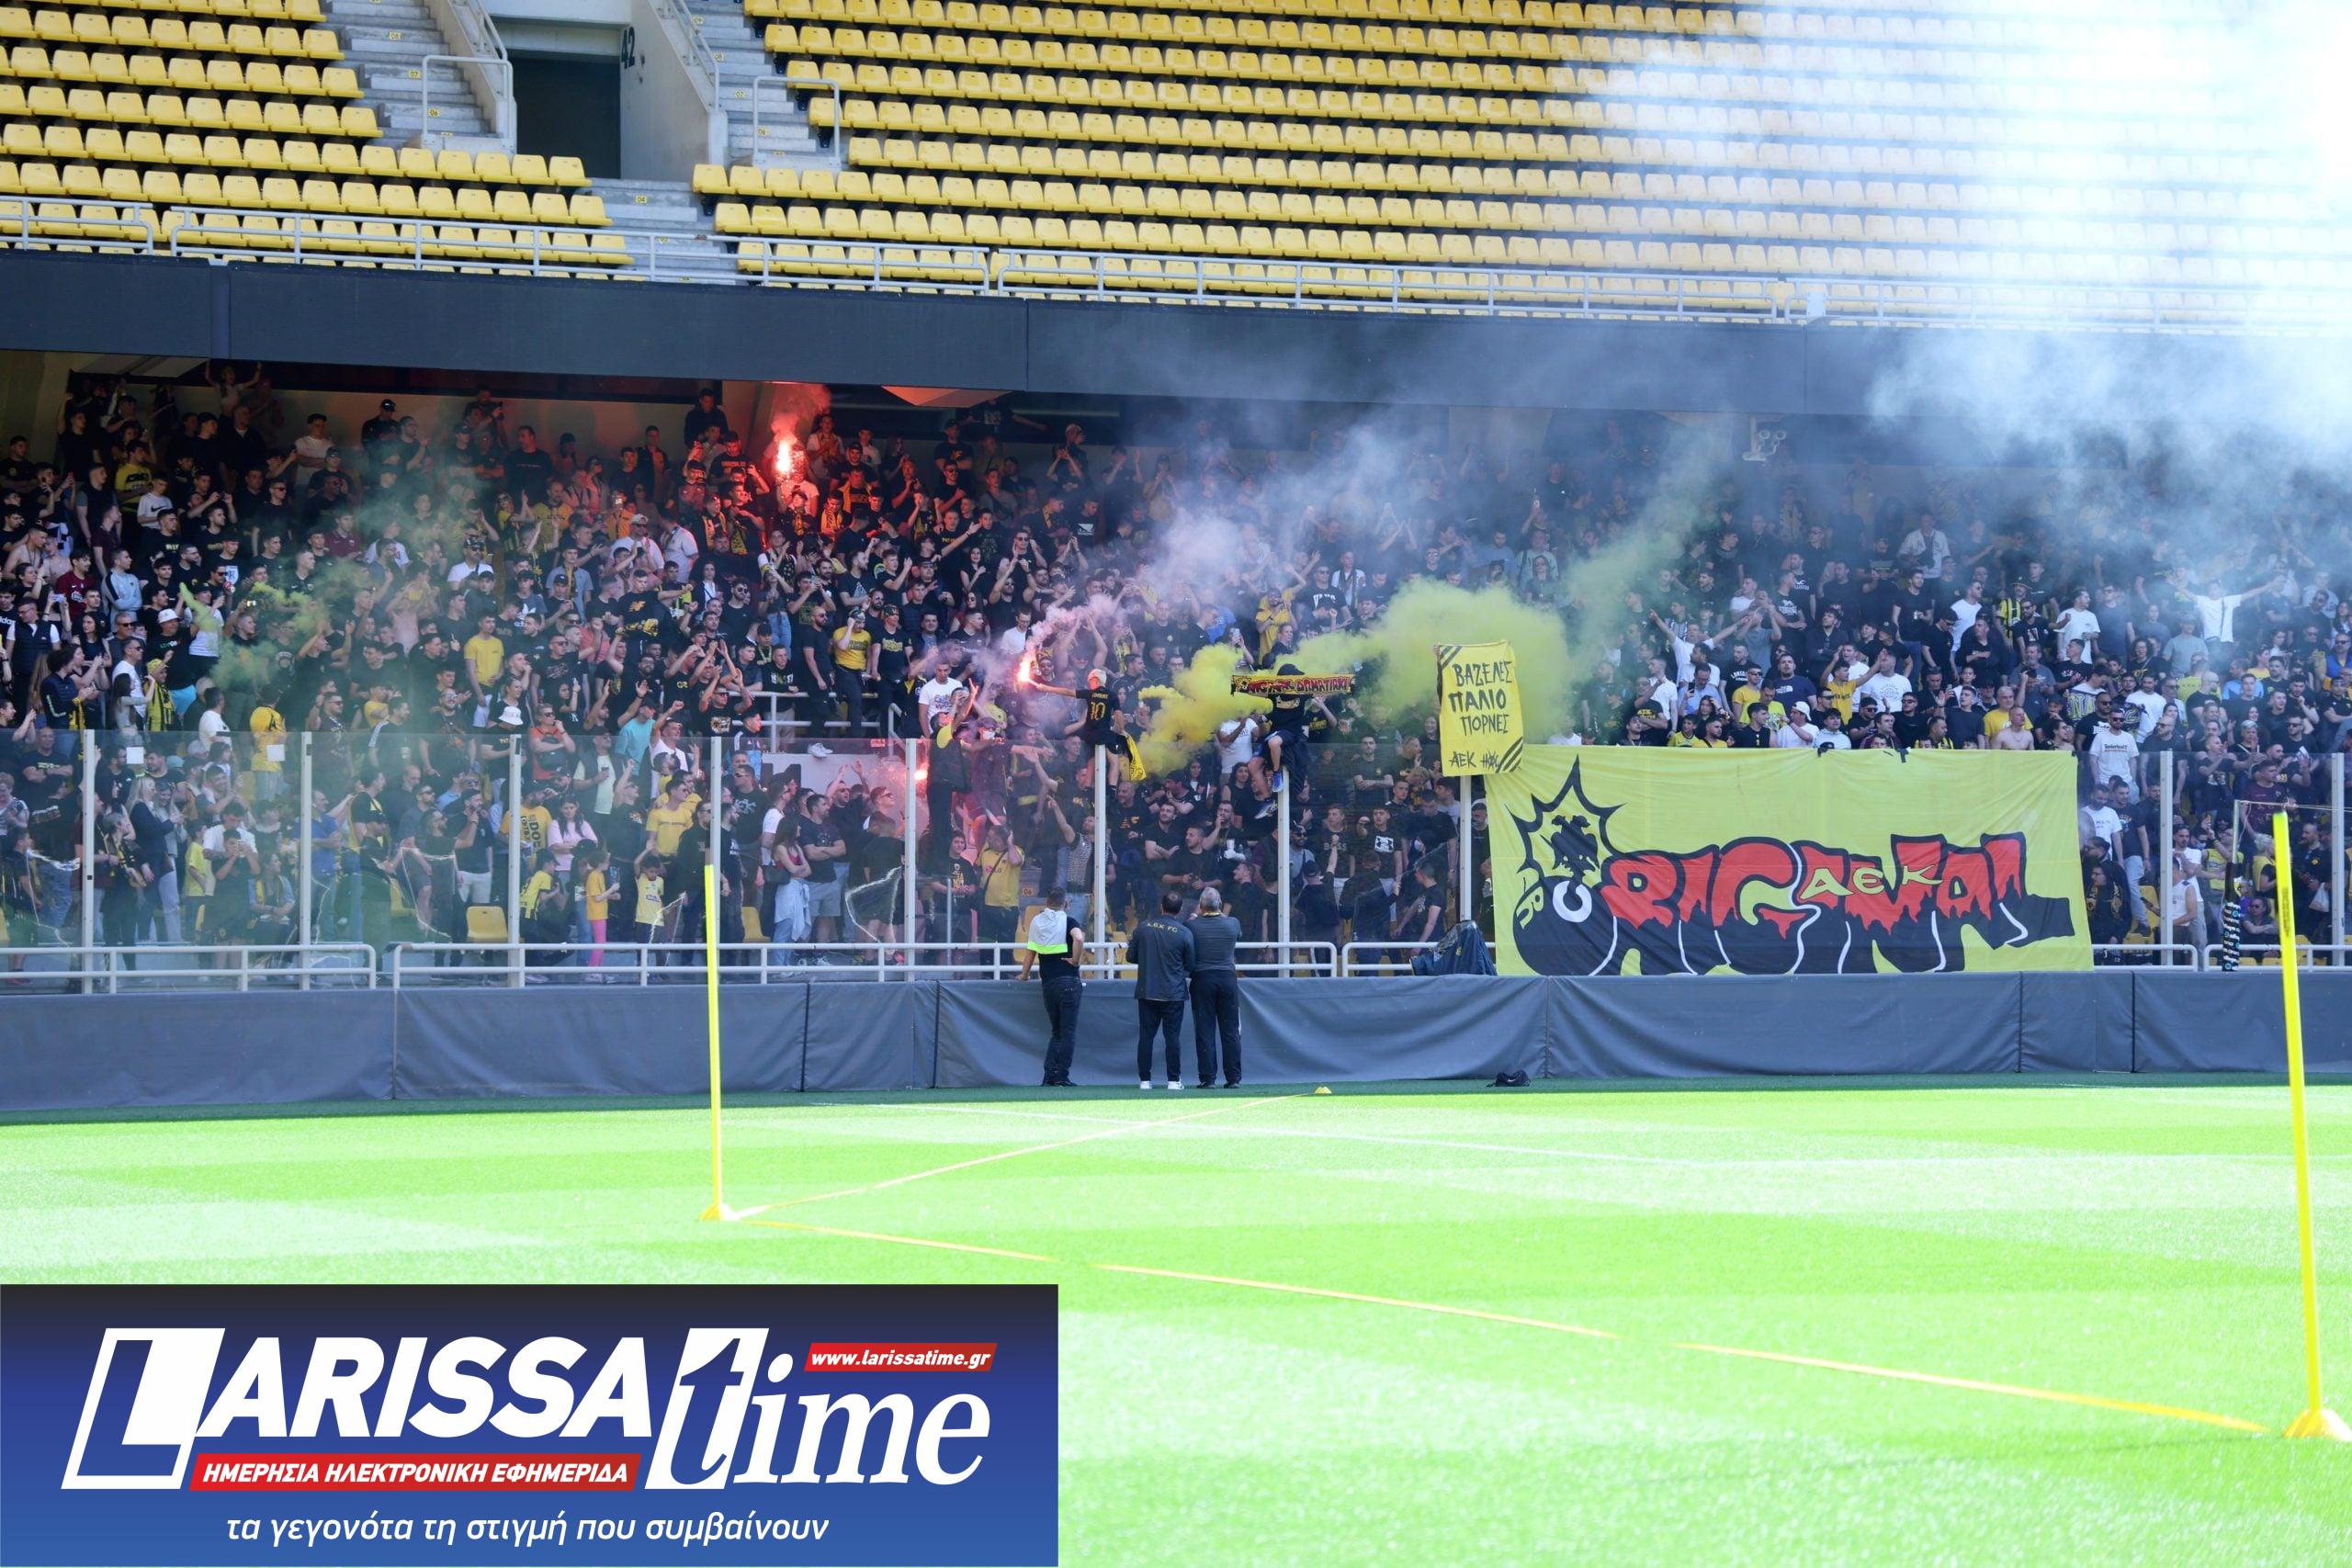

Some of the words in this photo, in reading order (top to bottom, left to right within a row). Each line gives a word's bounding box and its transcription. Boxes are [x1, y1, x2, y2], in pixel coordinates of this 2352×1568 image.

[621, 27, 636, 69] 42
[1453, 660, 1513, 687] ΒΑΖΕΛΕΣ
[1448, 688, 1507, 713] ΠΑΛΙΟ
[1460, 714, 1510, 737] ΠΟΡΝΕΣ
[1799, 863, 1944, 901] AEK
